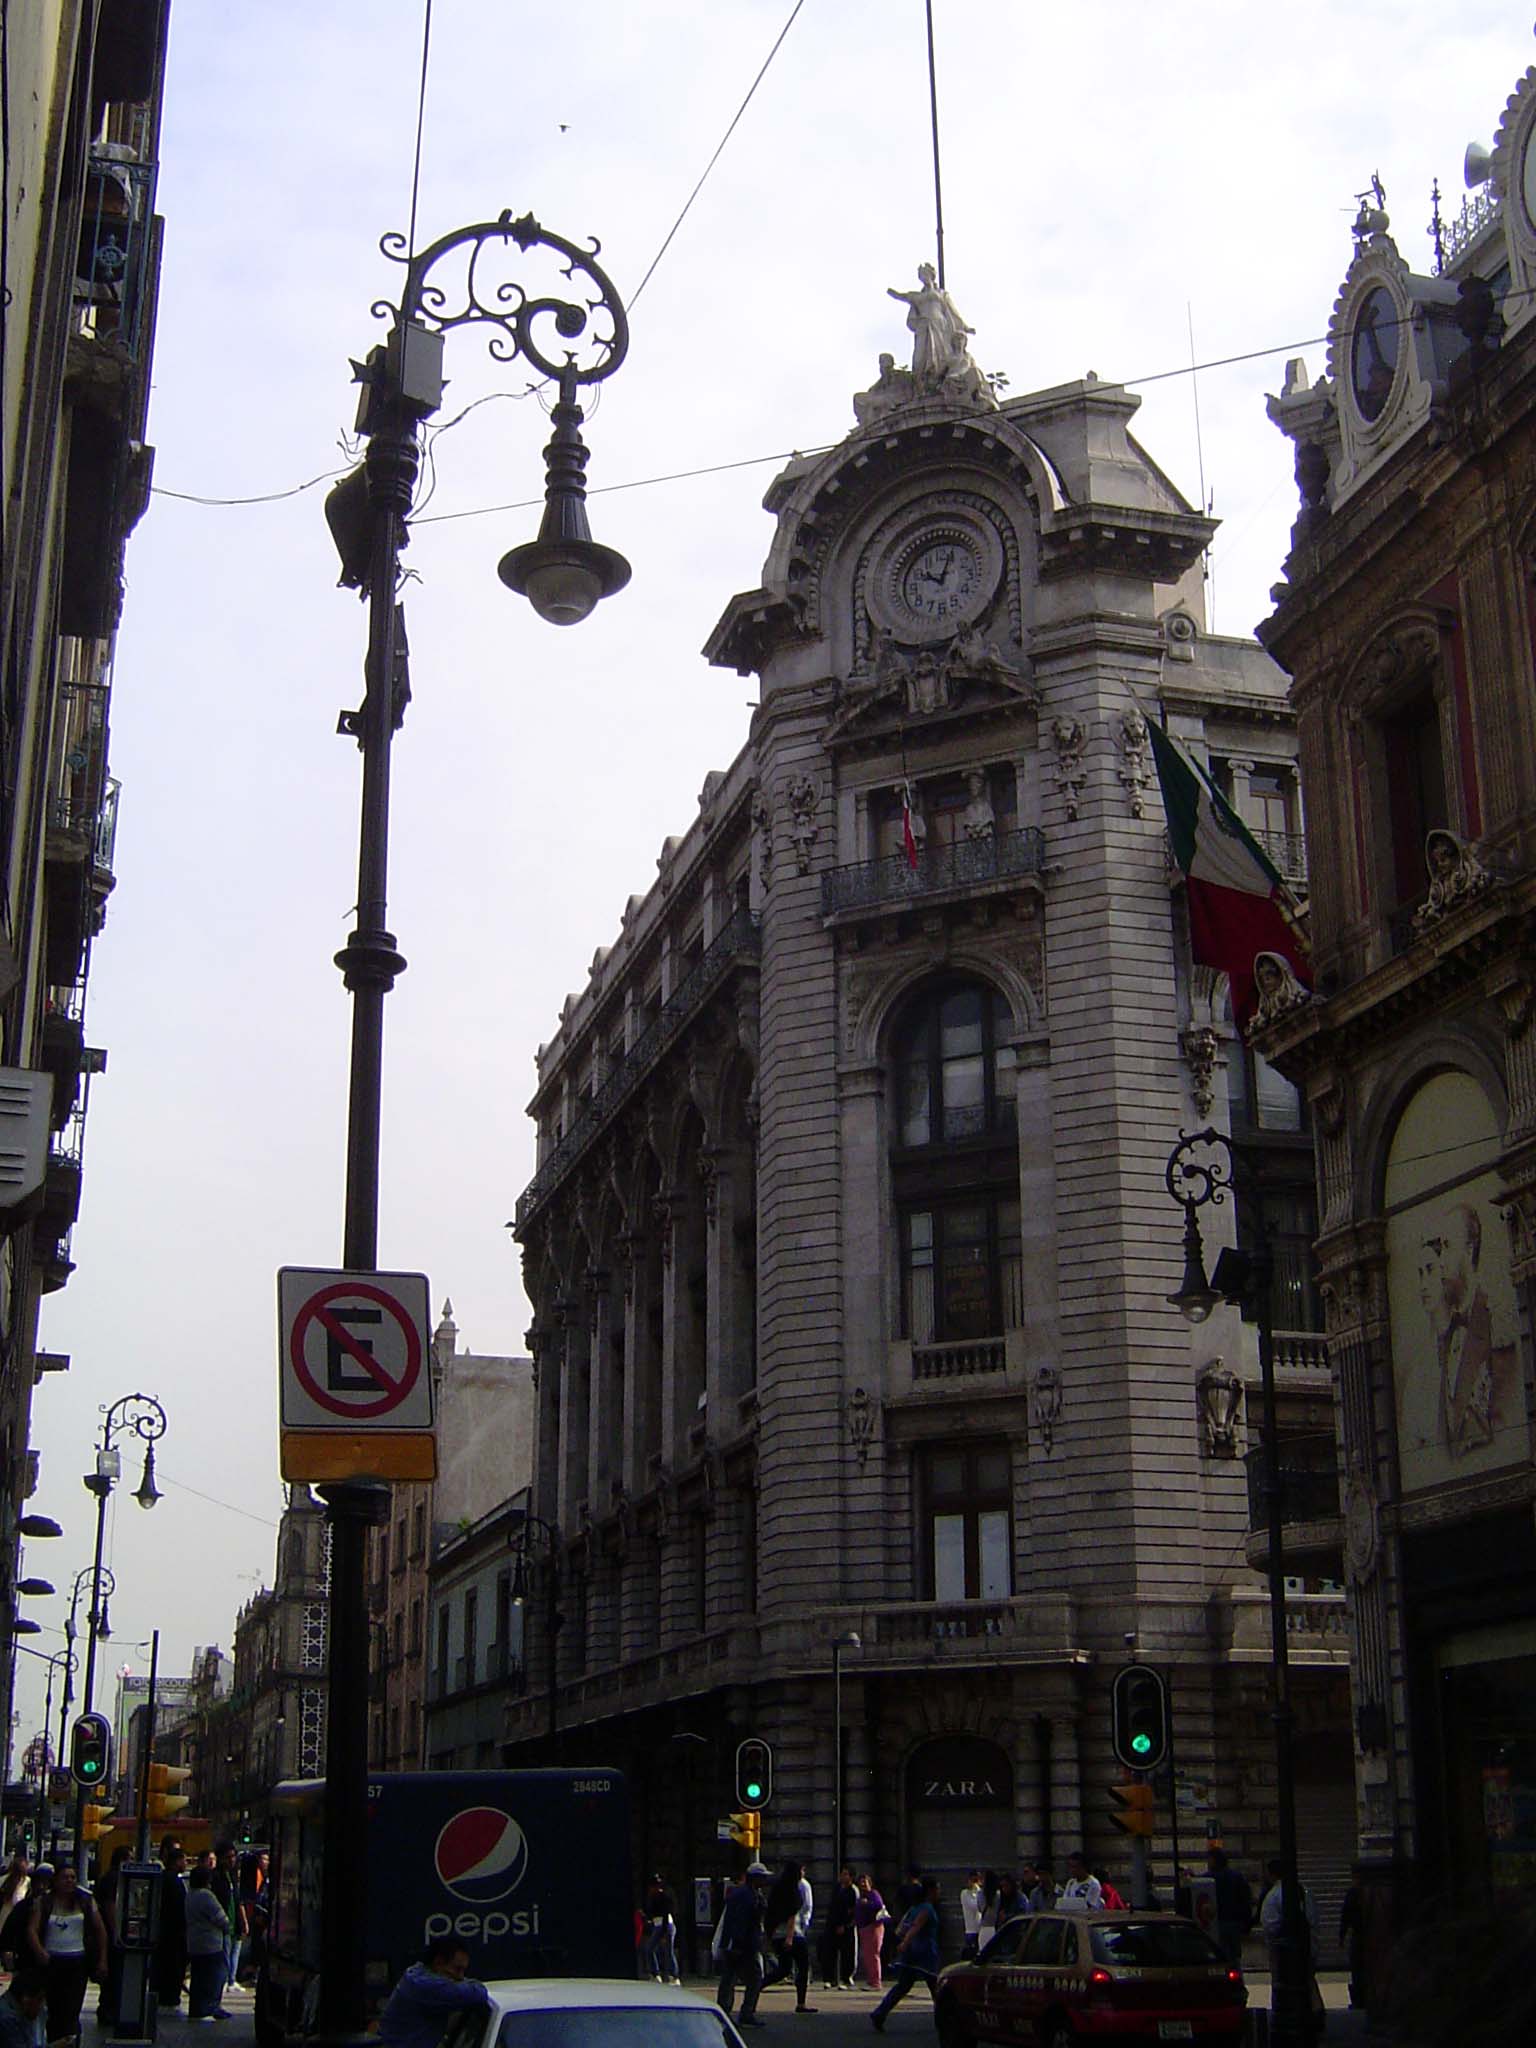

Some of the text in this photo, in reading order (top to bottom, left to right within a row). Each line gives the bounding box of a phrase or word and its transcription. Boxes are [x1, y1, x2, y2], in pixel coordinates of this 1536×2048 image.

[326, 1307, 388, 1391] E
[924, 1781, 995, 1796] ZARA
[424, 1904, 541, 1946] pepsi
